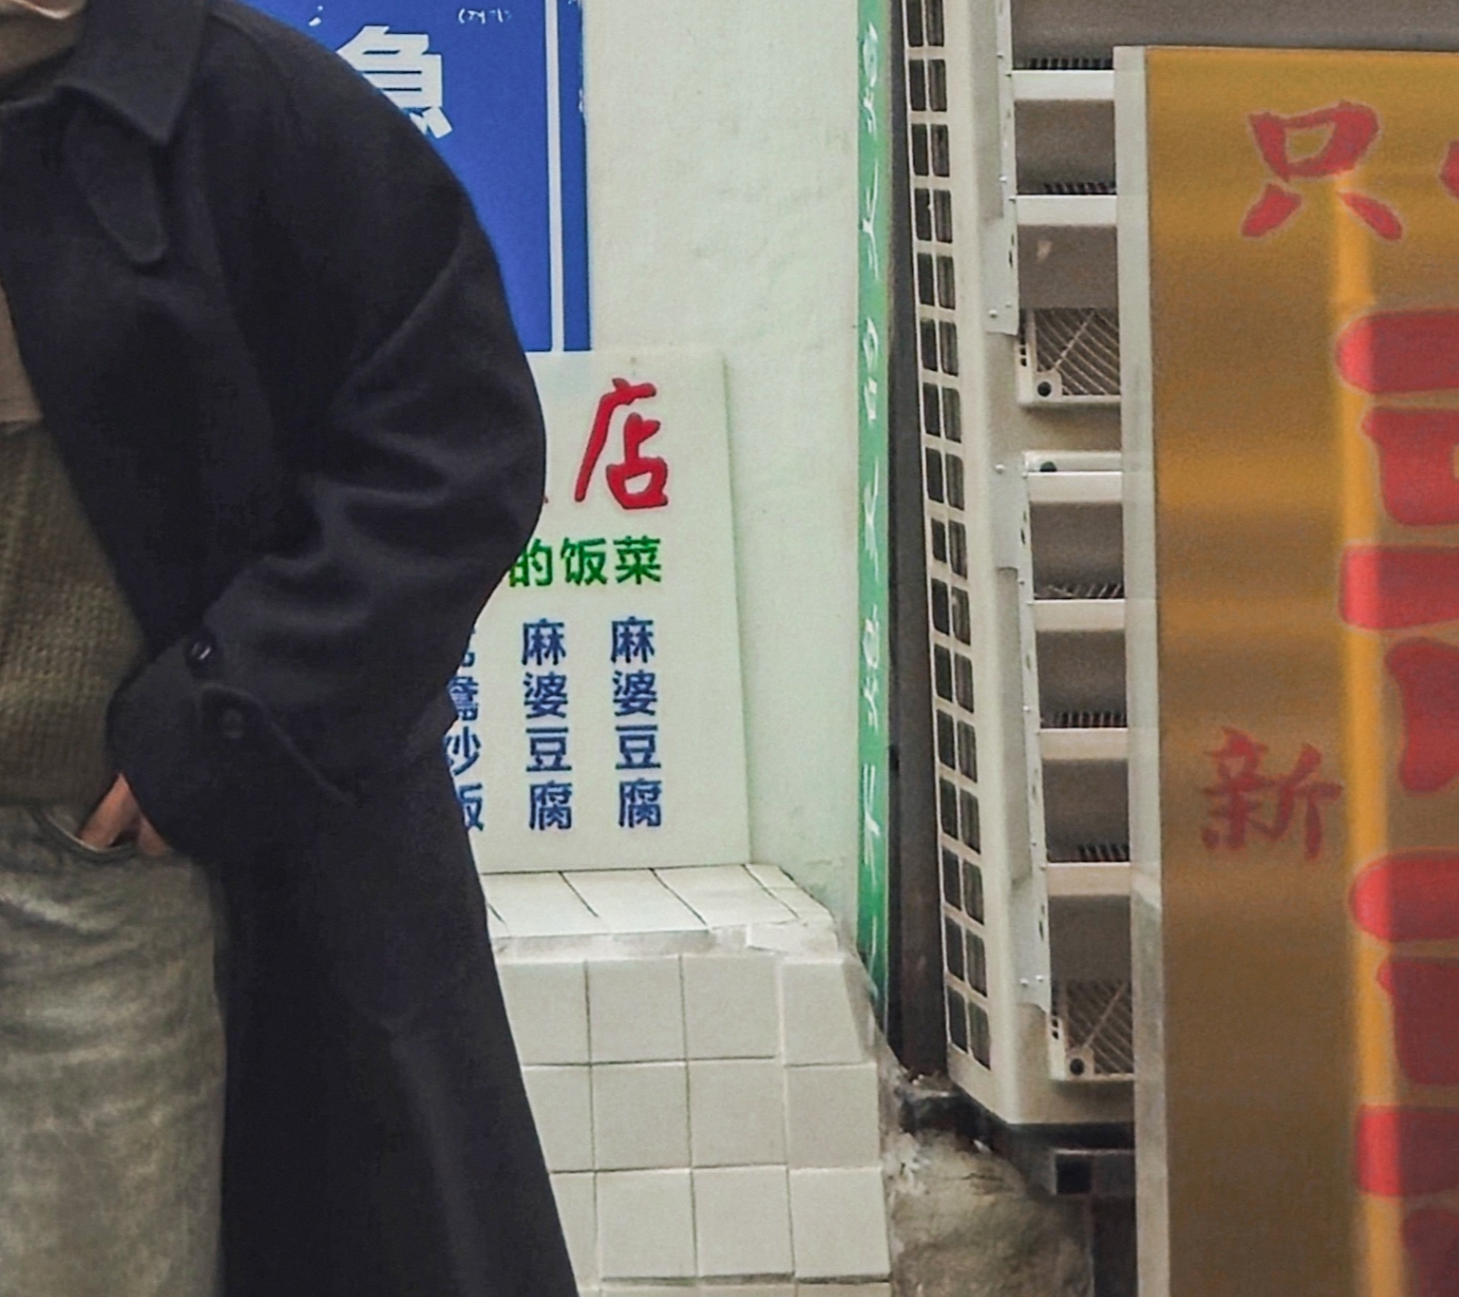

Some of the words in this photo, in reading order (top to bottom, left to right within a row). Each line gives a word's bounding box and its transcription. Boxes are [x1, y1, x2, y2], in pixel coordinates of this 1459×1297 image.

[1241, 99, 1459, 243] 只
[574, 377, 669, 511] 店
[508, 534, 662, 588] 的饭菜
[521, 617, 573, 831] 麻婆豆腐
[610, 615, 663, 828] 麻婆豆腐
[1200, 726, 1343, 863] 新
